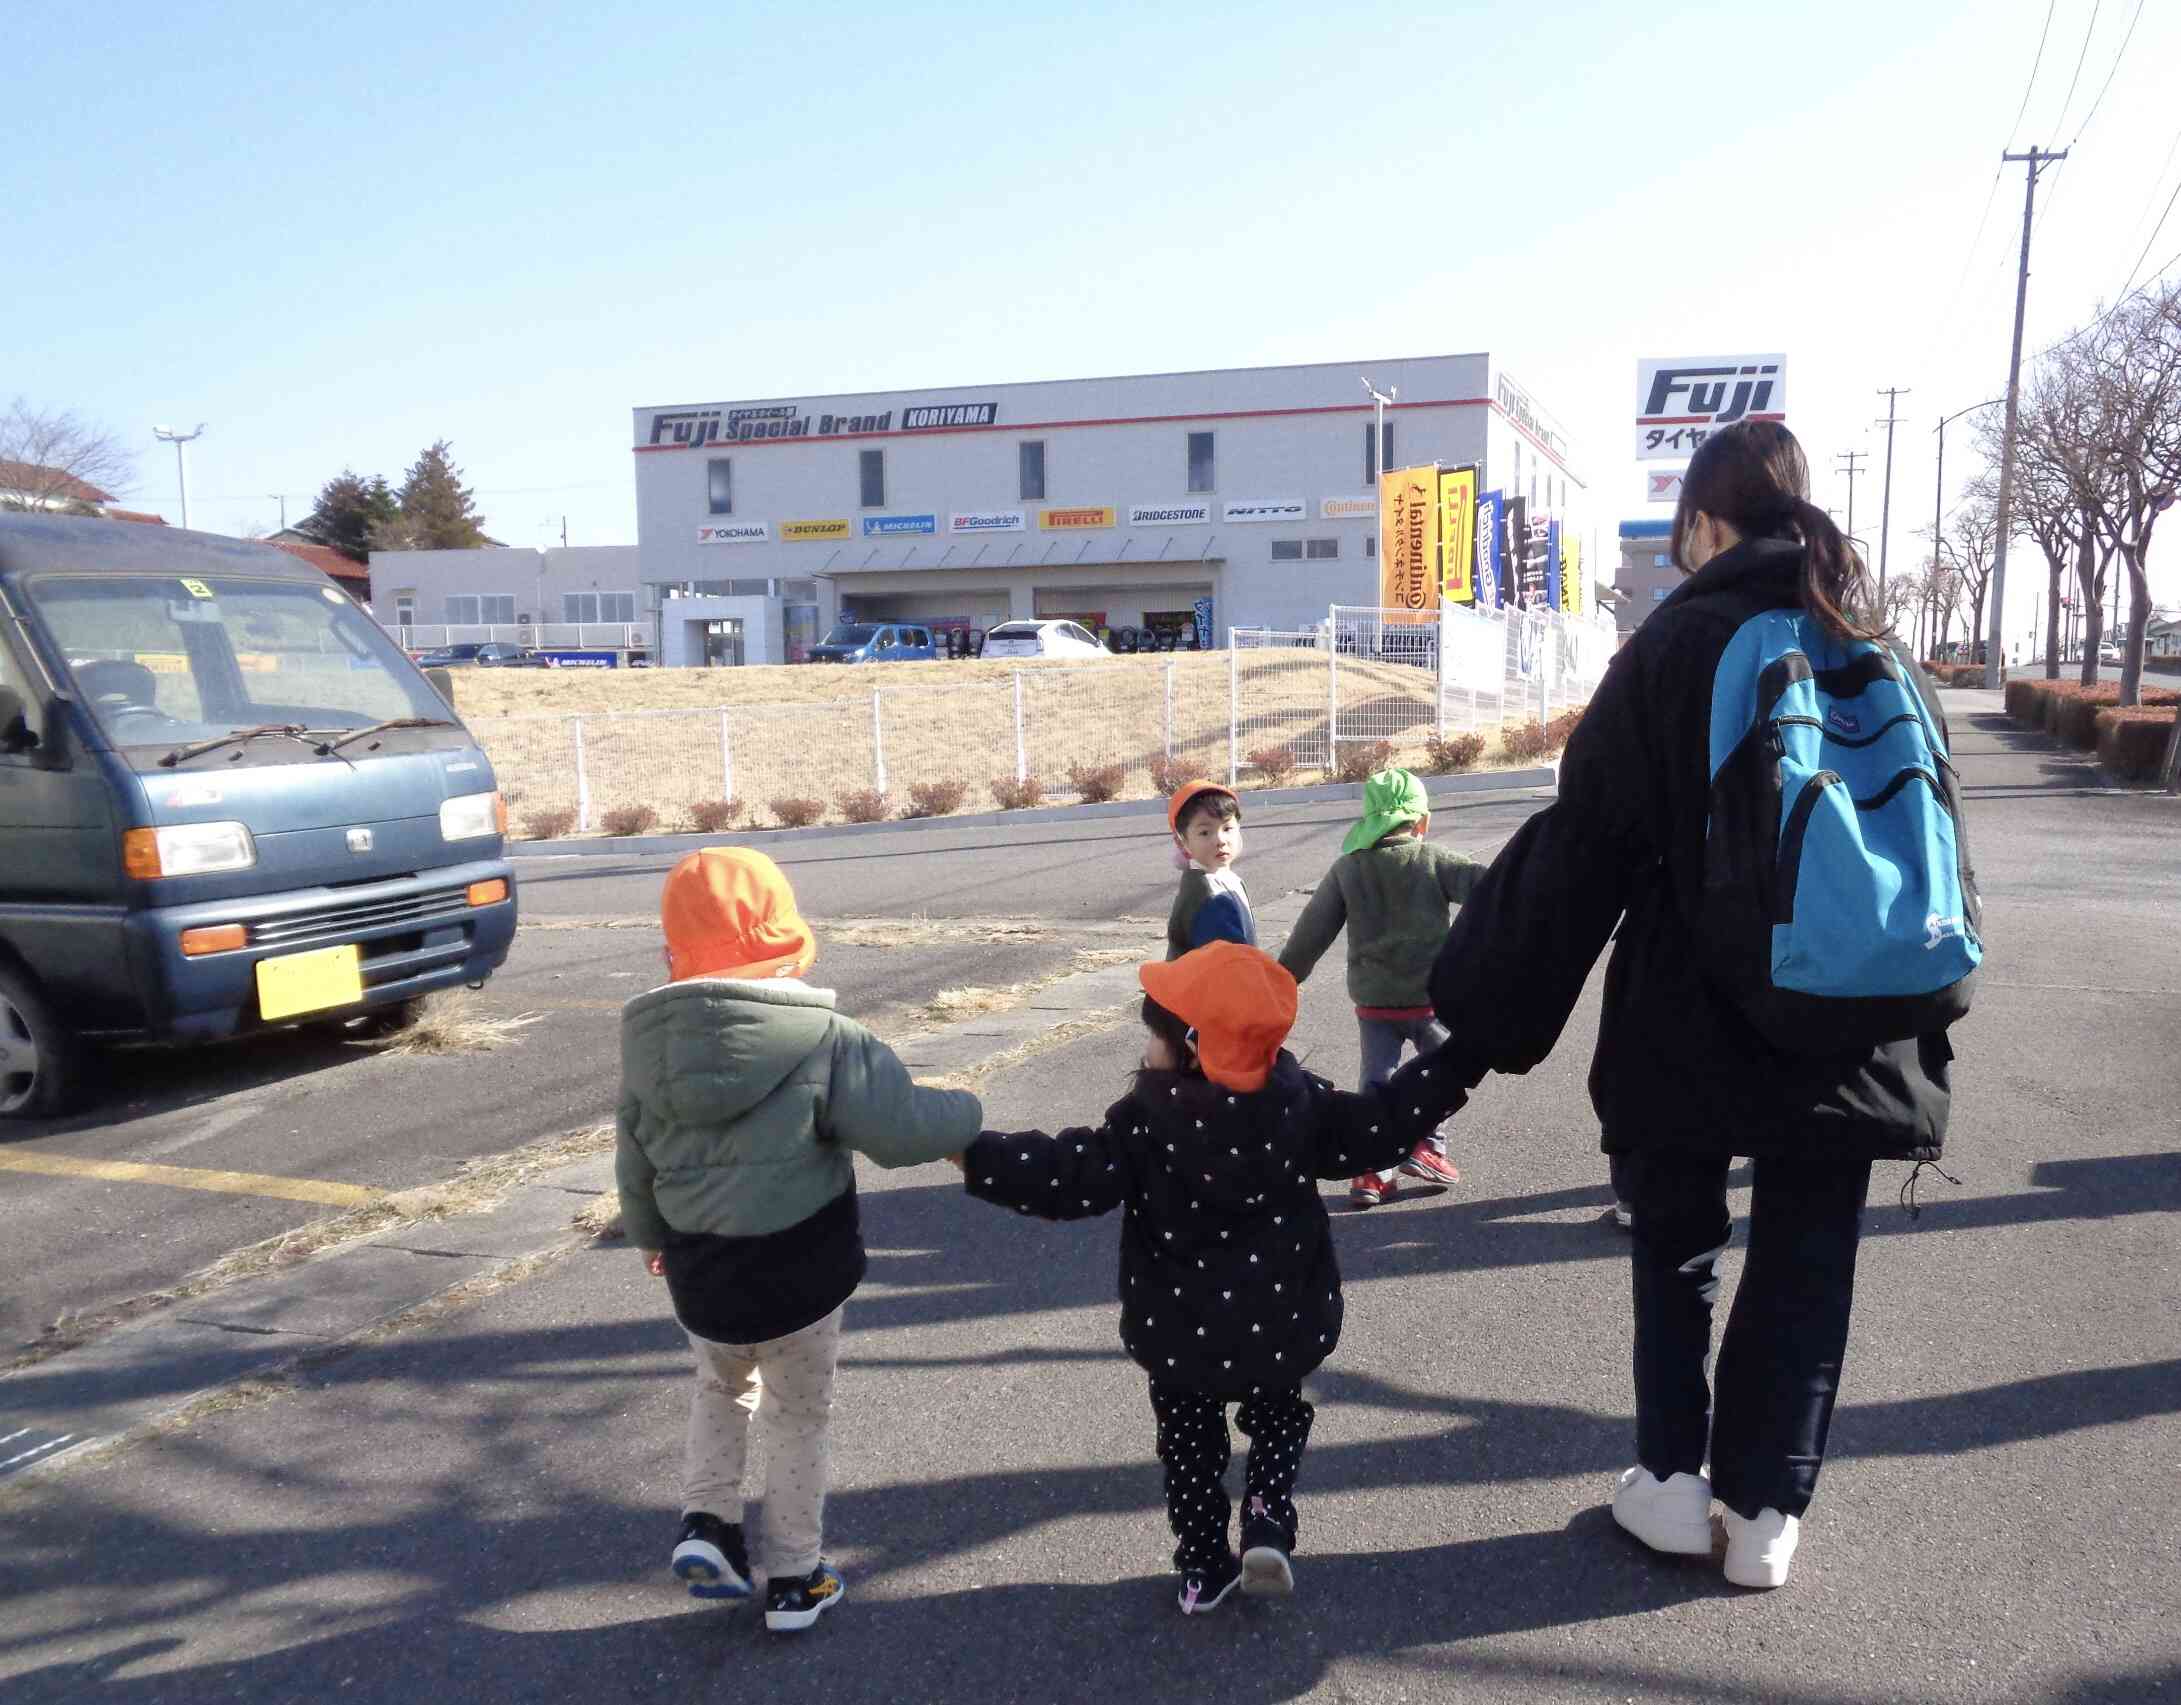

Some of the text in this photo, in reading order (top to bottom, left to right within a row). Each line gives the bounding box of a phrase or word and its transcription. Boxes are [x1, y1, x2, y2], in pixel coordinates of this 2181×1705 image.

[1645, 365, 1778, 423] Fuji
[650, 406, 989, 448] Fuji Special Brand KORIYAMA
[1132, 508, 1206, 521] BRIDGESTONE
[1228, 506, 1302, 515] NITTO
[954, 515, 1019, 527] BFGoodrich
[1049, 510, 1105, 526] PIRELLI
[793, 524, 846, 534] DUNLOP
[883, 520, 932, 531] MICHELIN
[714, 527, 764, 538] YOKOHAMA
